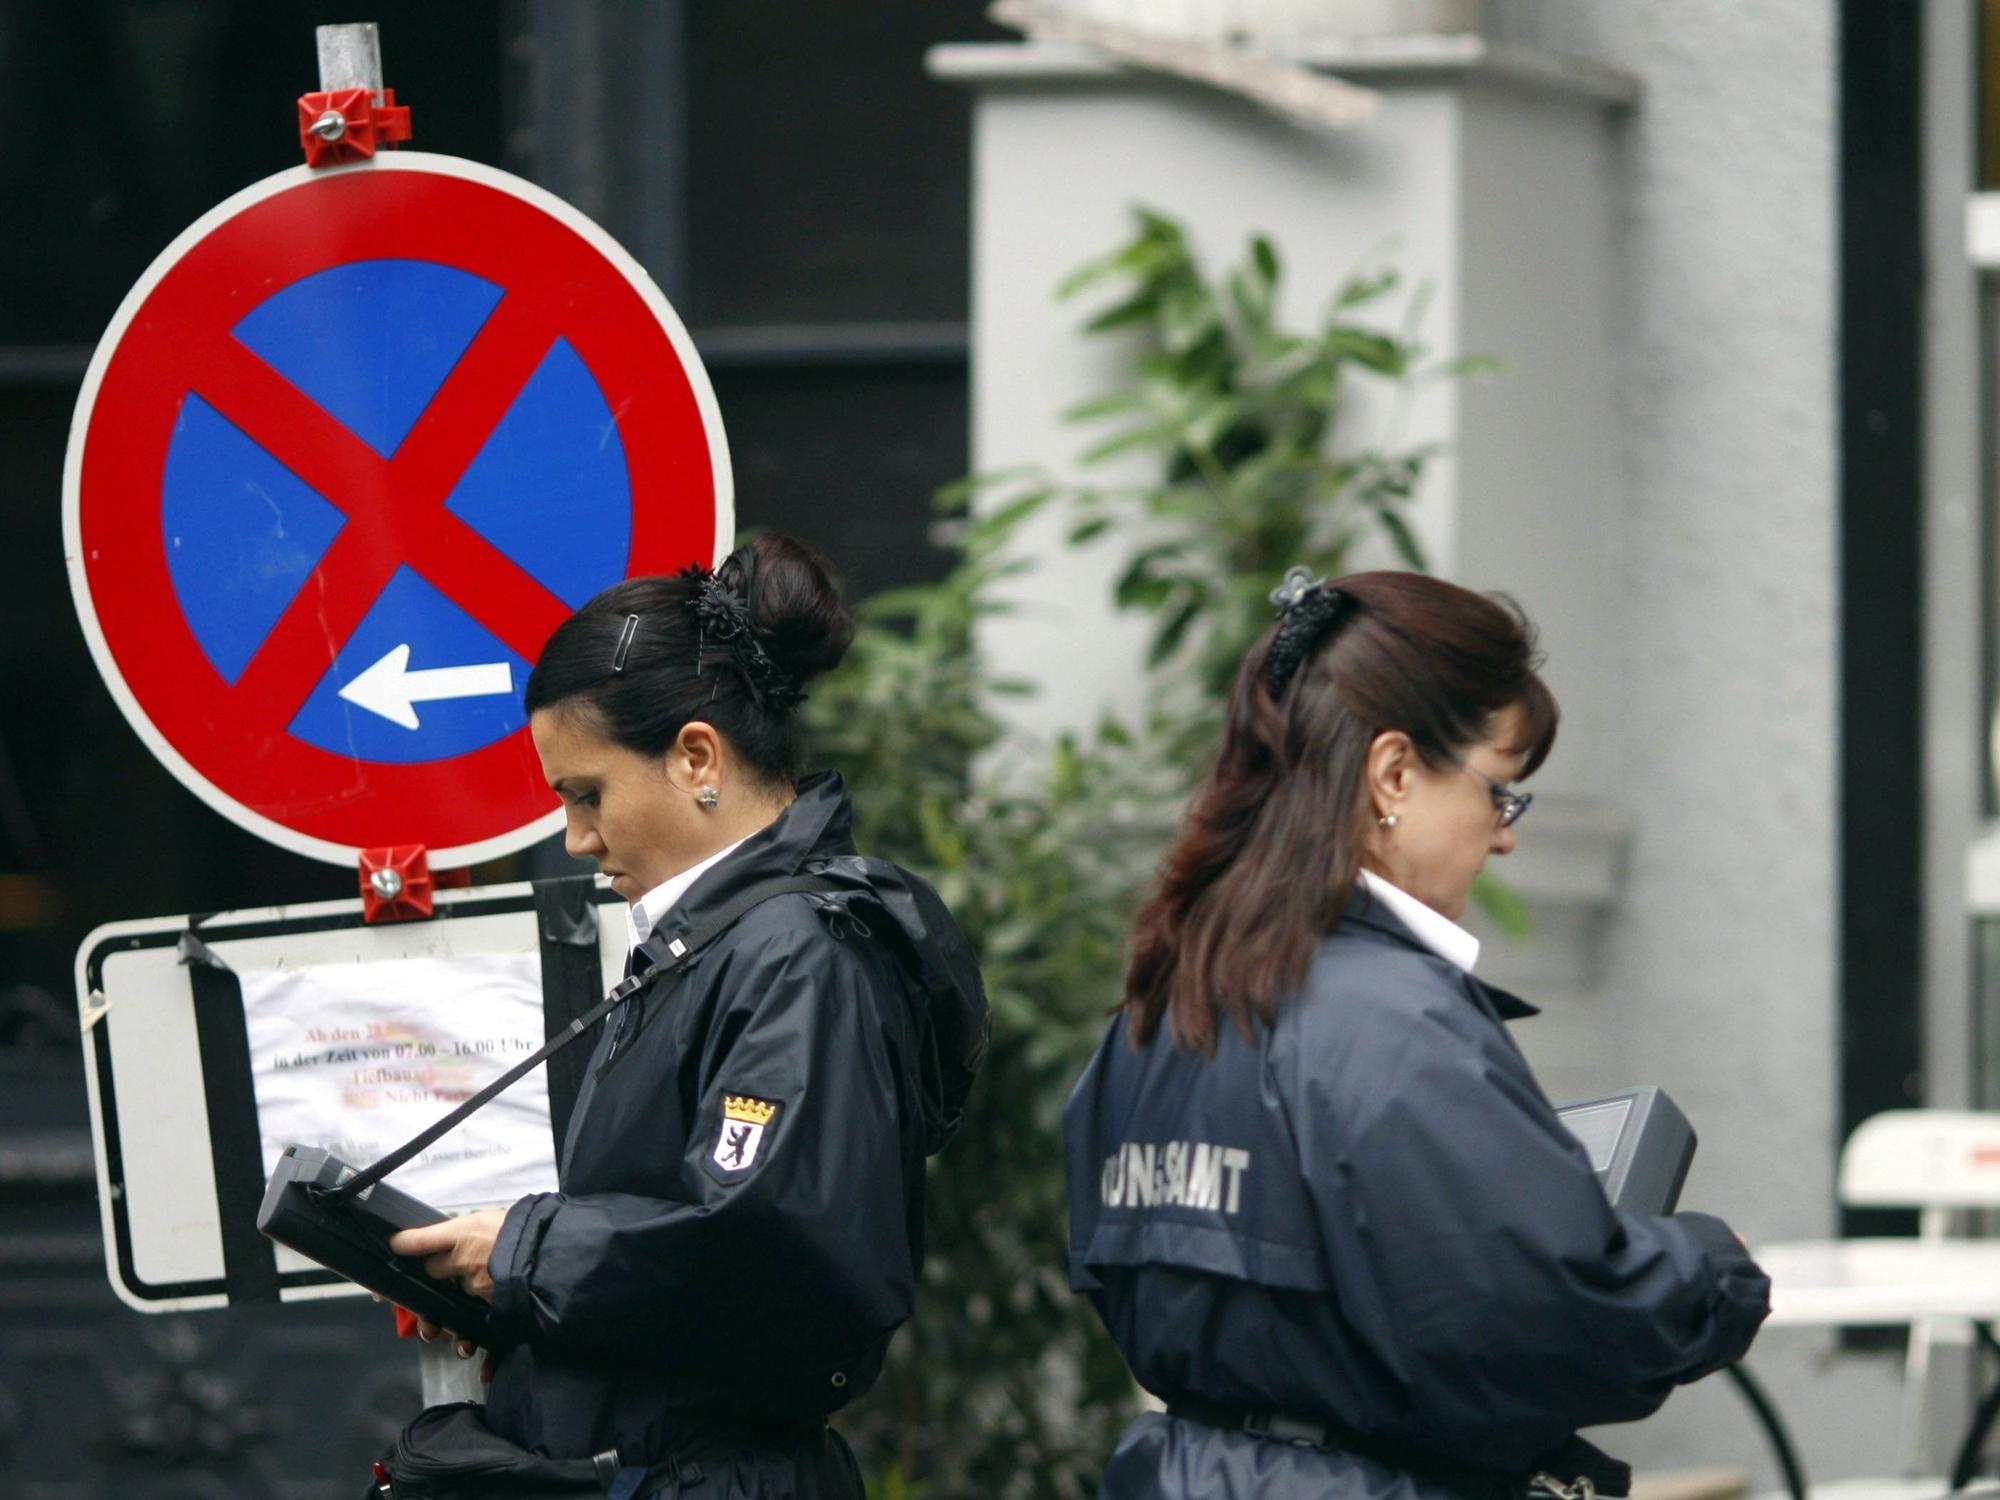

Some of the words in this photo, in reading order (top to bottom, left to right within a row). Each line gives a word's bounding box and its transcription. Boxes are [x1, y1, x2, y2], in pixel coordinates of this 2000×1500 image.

[330, 1027, 360, 1041] den
[273, 1053, 289, 1069] in
[293, 1052, 319, 1067] der
[325, 1047, 358, 1063] Zeit
[362, 1047, 391, 1059] von
[395, 1043, 436, 1057] 07.00
[454, 1038, 495, 1056] 16.00
[501, 1037, 534, 1052] Uhr
